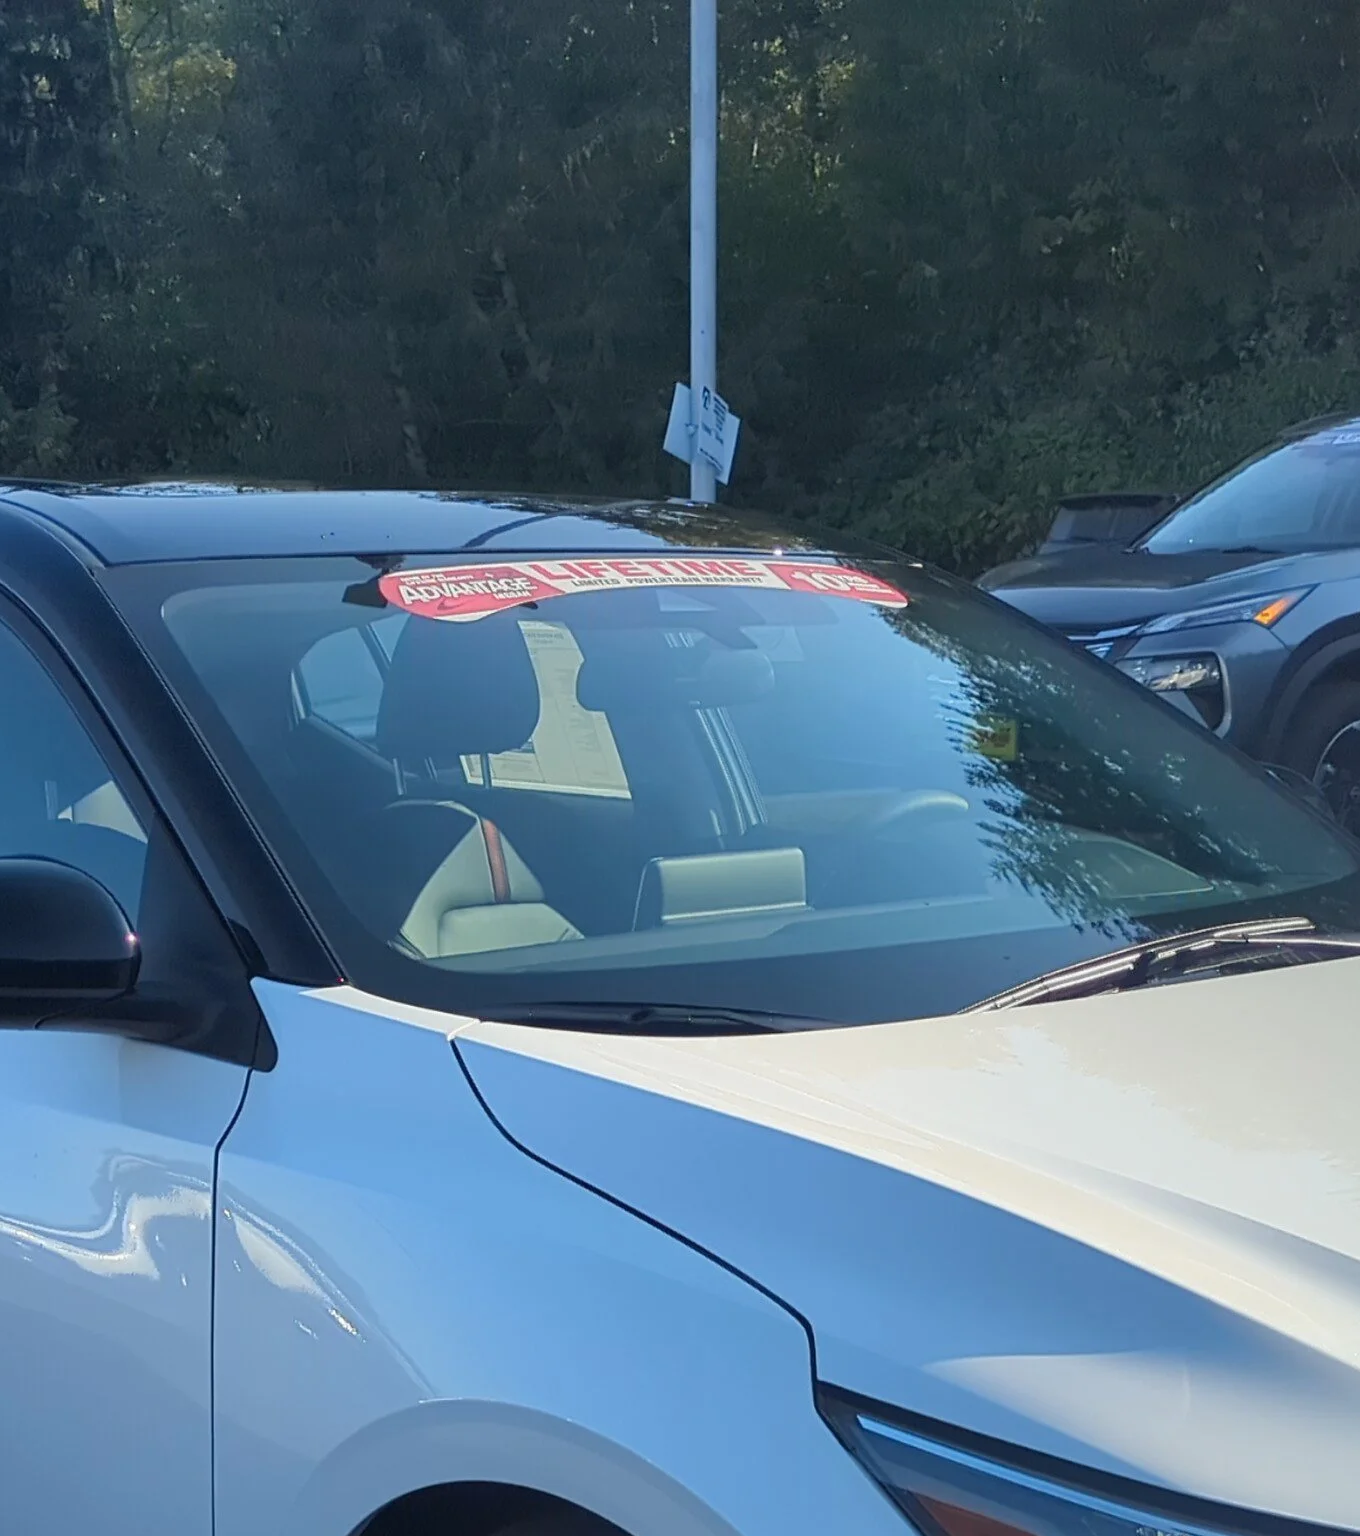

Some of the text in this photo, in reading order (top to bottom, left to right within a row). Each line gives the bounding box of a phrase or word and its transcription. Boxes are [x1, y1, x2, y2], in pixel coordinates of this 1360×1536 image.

[529, 560, 767, 580] LIFETIME
[398, 577, 538, 605] ADVANTAGE
[571, 576, 764, 588] LIMITED POWERTRAIN WARRANTY
[790, 571, 852, 591] 10
